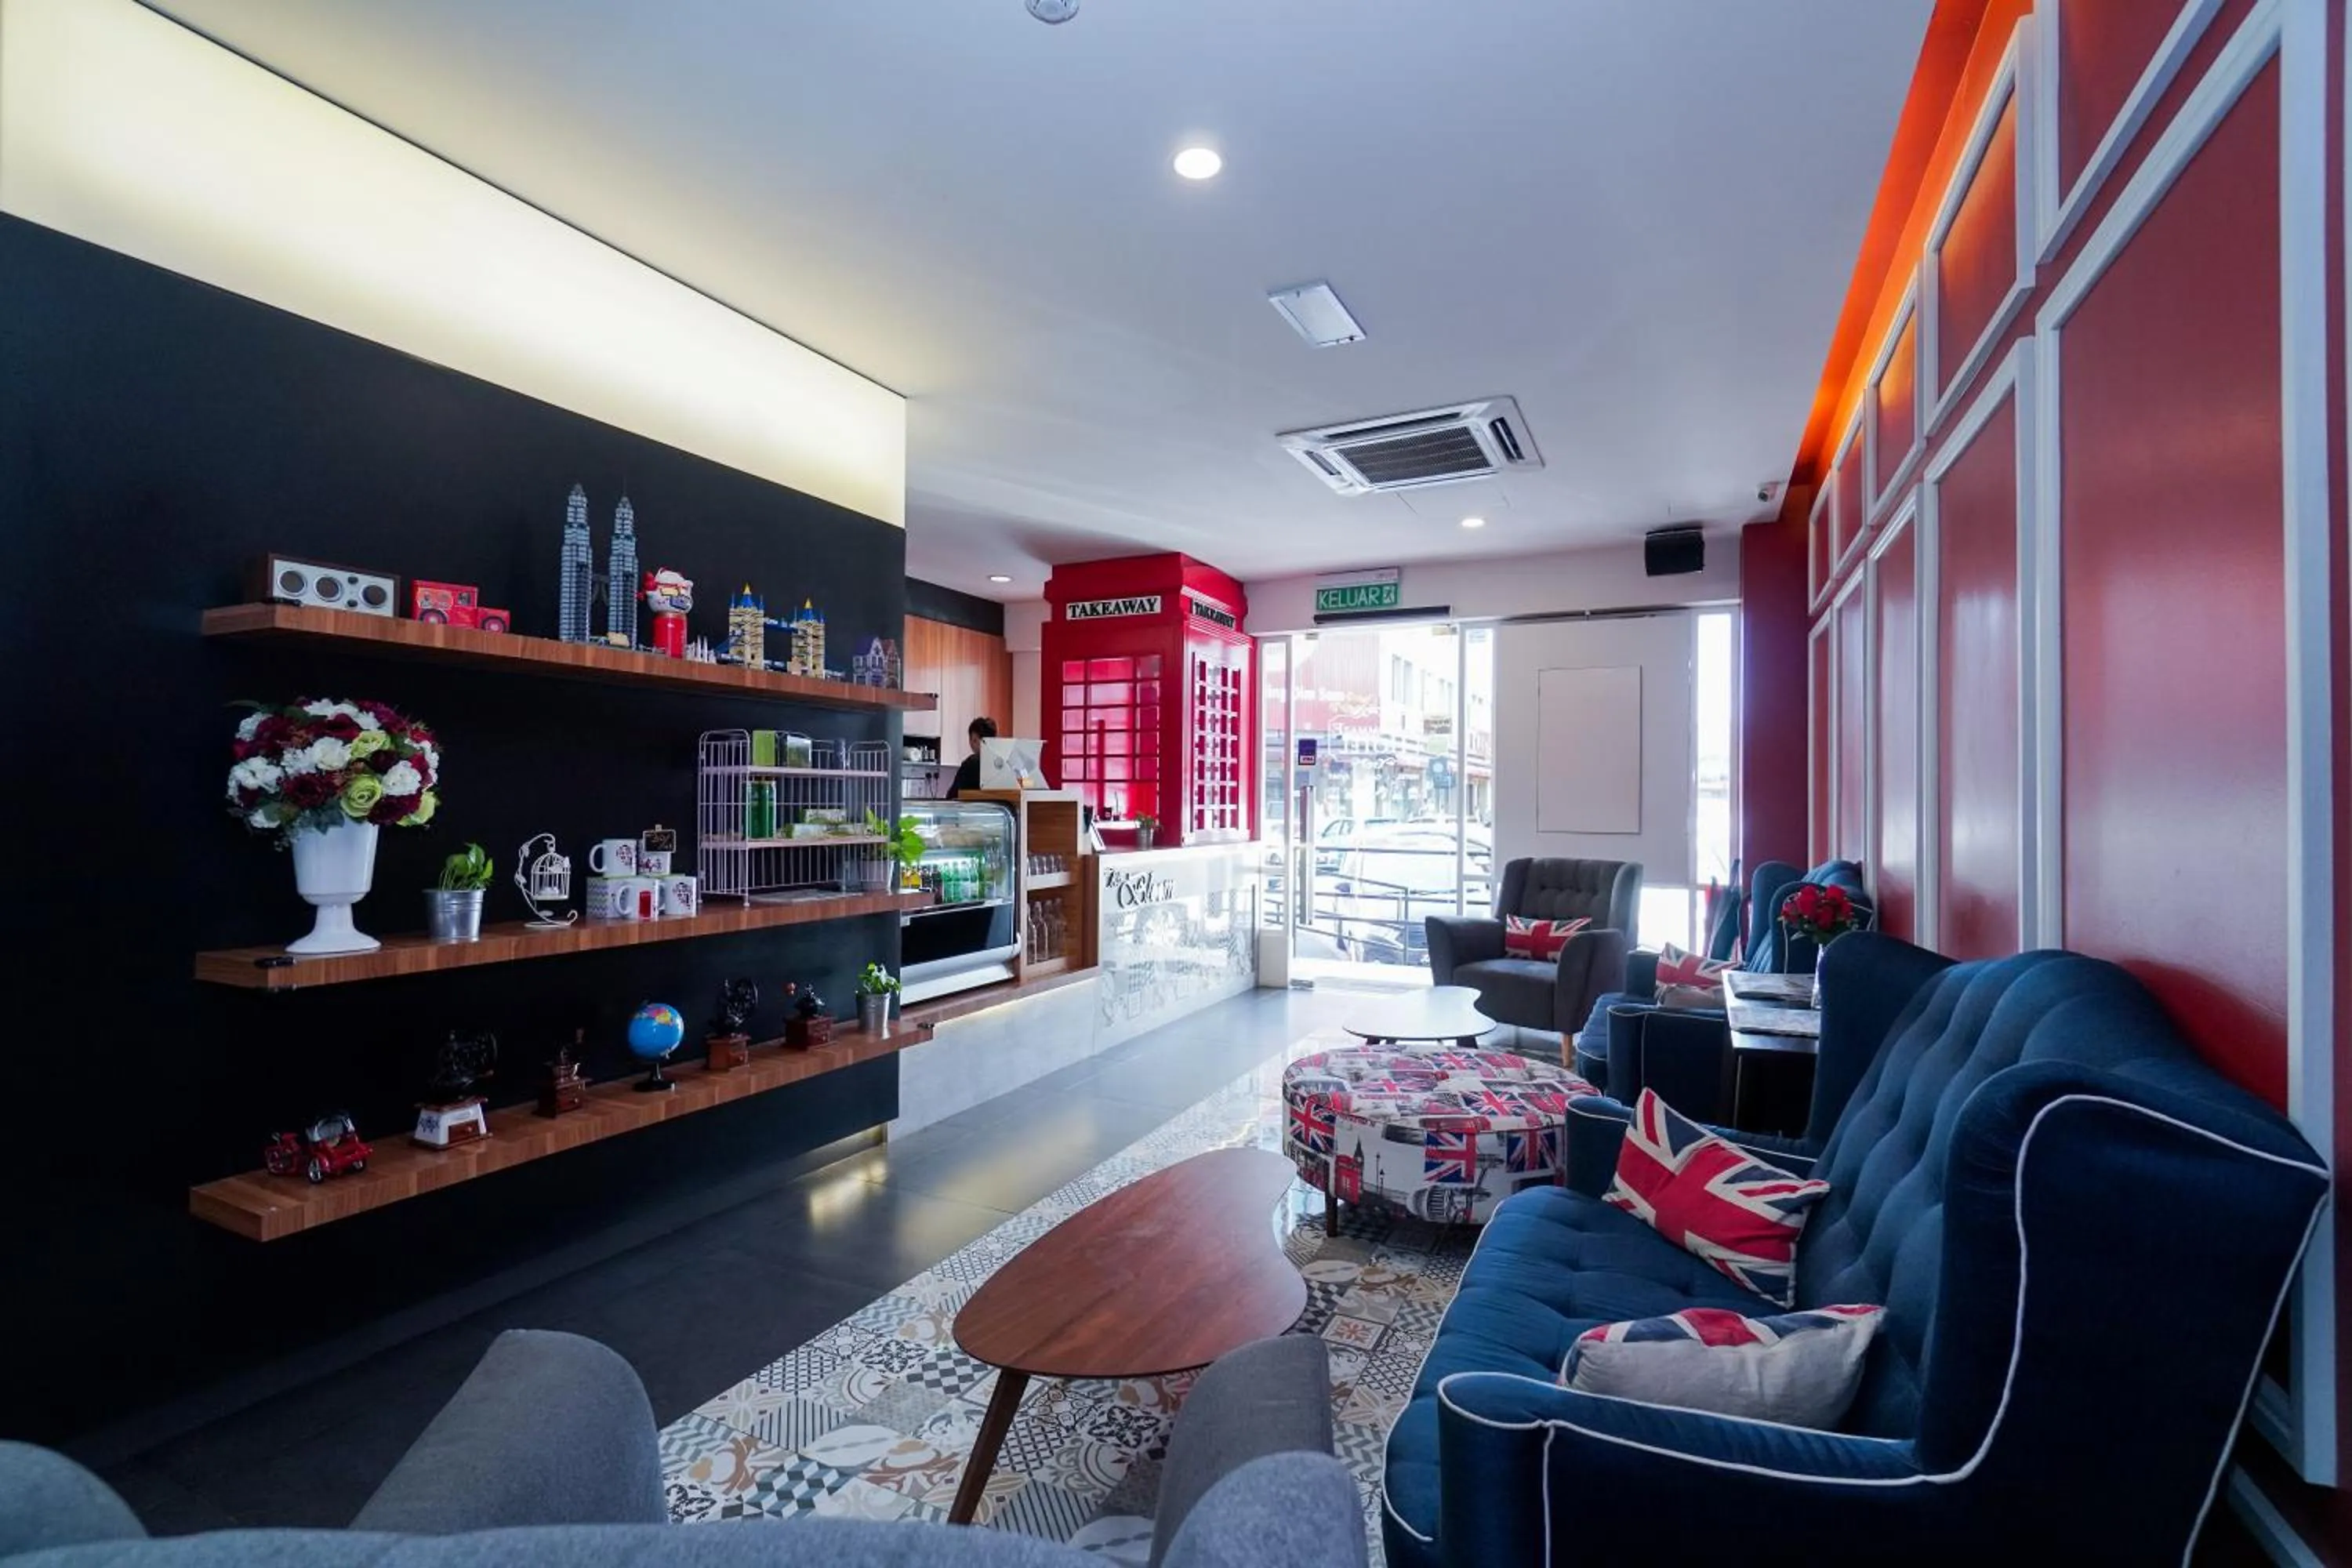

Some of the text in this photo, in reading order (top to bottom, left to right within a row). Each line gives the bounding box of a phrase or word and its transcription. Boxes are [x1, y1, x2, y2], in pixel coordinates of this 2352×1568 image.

[1319, 586, 1381, 608] KELUAR
[1069, 598, 1158, 619] TAKEAWAY
[1193, 601, 1235, 628] TAKEAWAY
